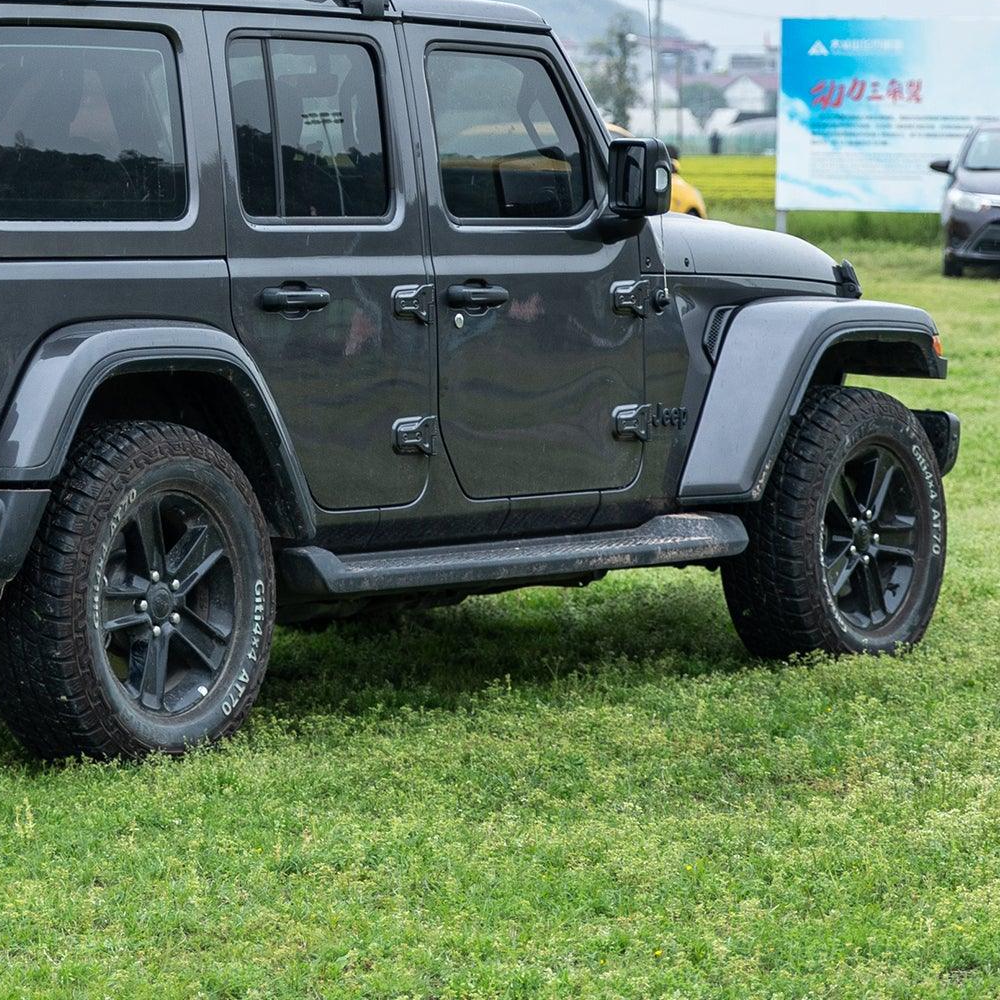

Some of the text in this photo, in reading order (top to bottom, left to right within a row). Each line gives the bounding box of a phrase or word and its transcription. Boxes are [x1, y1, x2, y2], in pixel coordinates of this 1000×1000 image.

[651, 402, 688, 430] Jeep
[221, 579, 265, 717] Giti4x4 AT70
